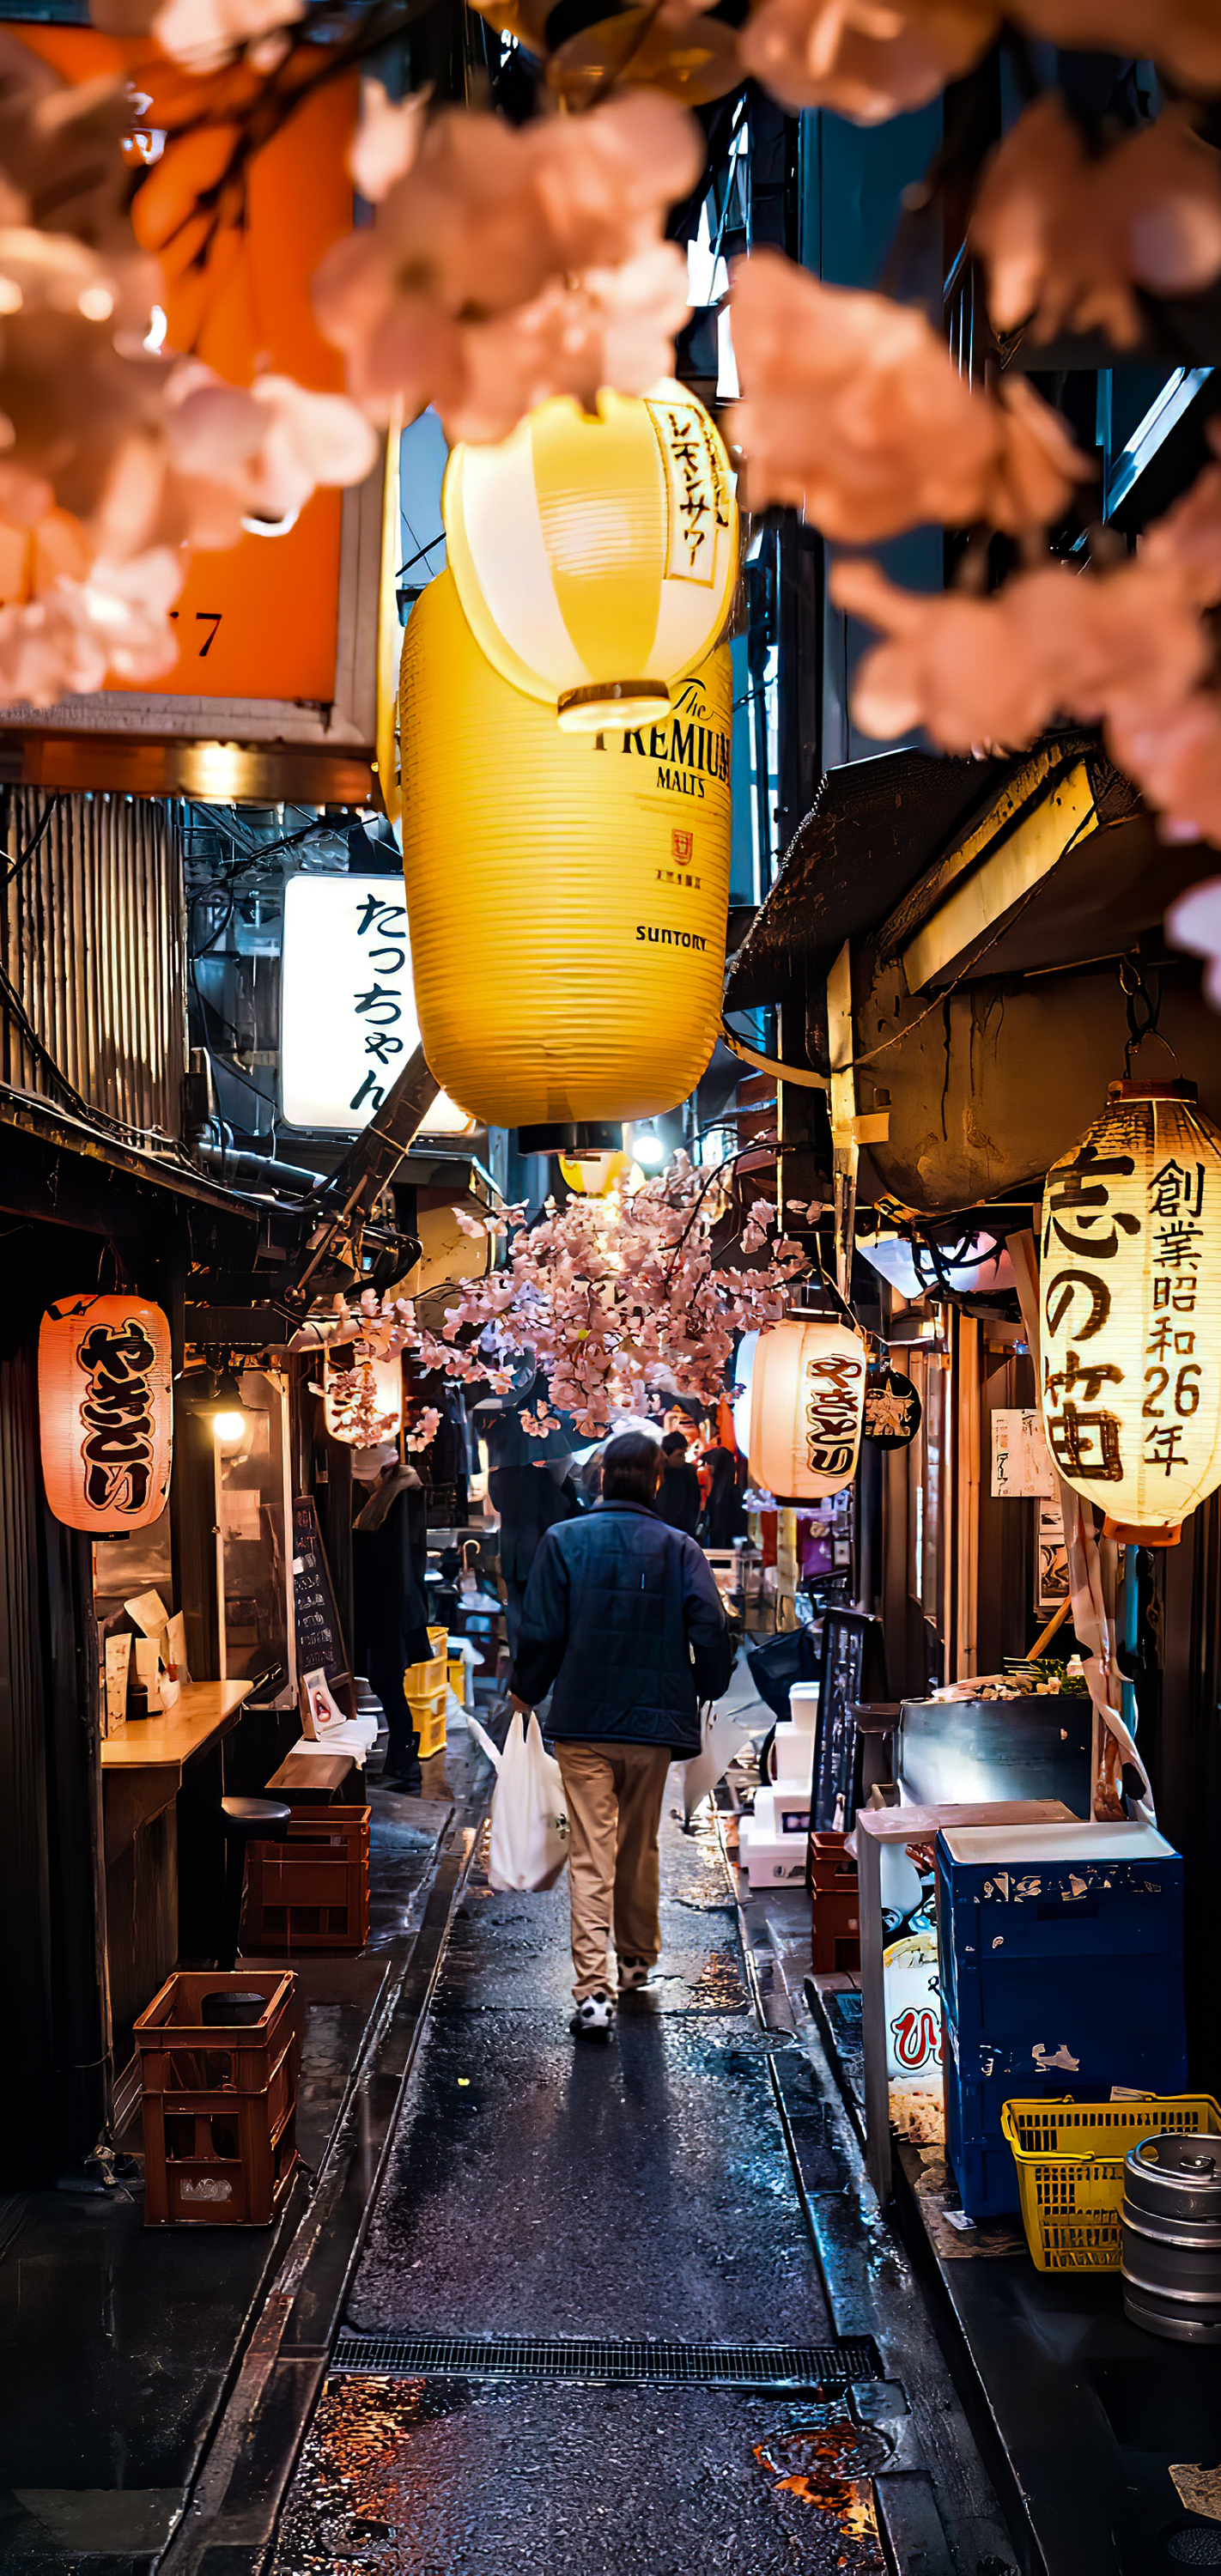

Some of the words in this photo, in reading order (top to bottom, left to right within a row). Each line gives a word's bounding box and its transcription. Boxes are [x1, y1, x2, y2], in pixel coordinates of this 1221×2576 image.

[673, 678, 716, 721] The
[656, 766, 706, 799] MALTS
[635, 926, 708, 951] SUNTORY
[349, 893, 407, 1111] たっちゃん
[1141, 1157, 1206, 1477] 創業昭和26年
[77, 1318, 155, 1513] やきとり
[806, 1354, 862, 1477] やきとり
